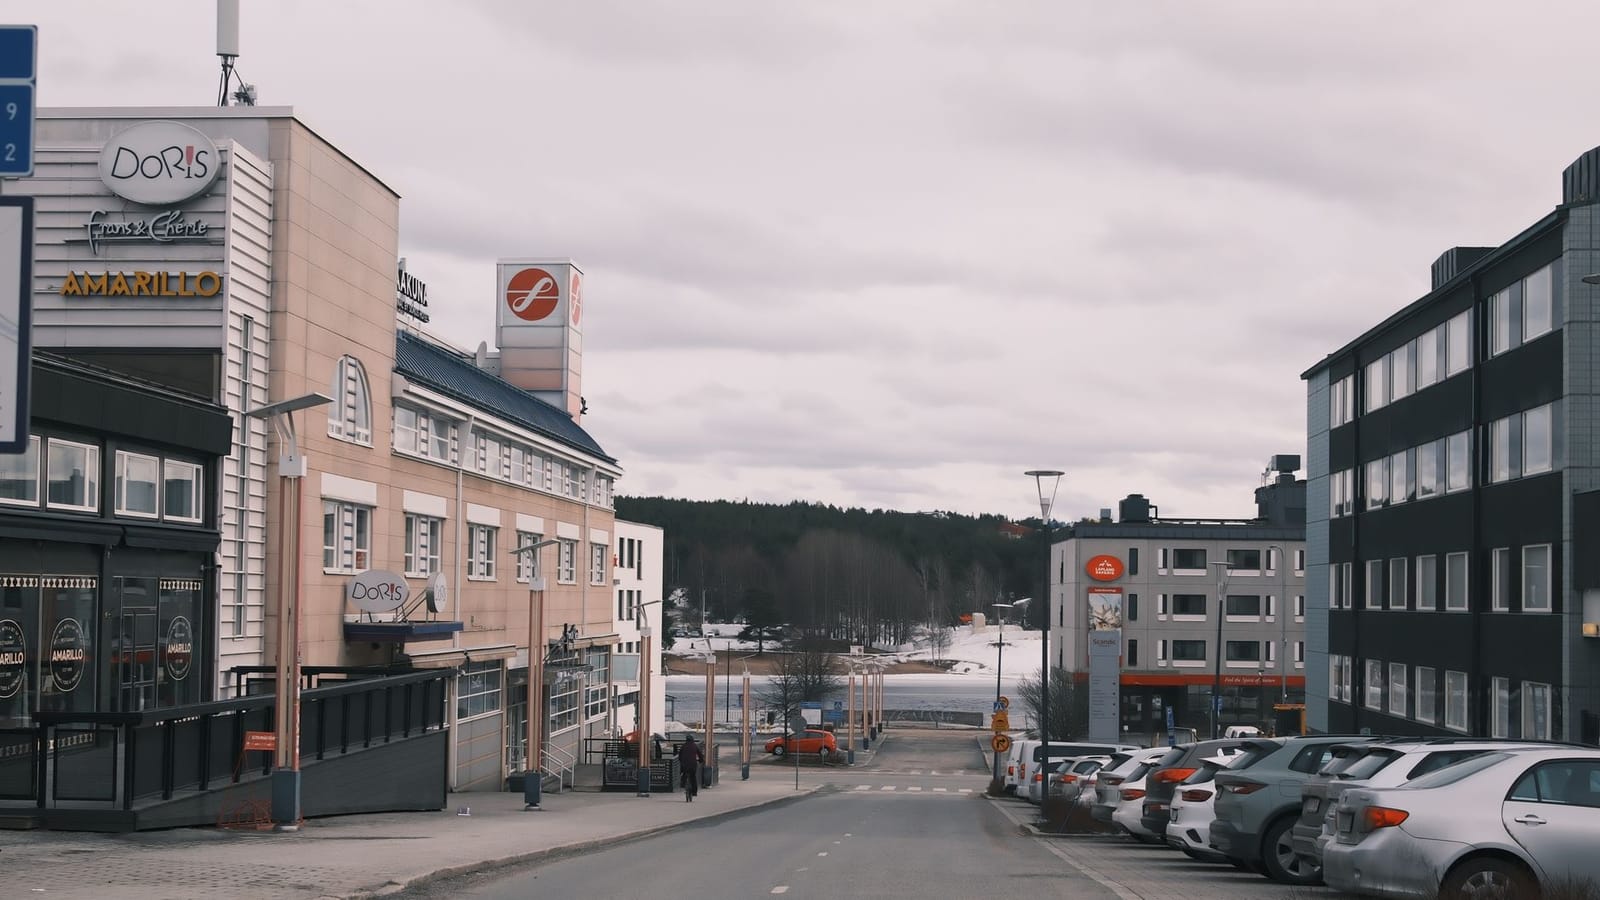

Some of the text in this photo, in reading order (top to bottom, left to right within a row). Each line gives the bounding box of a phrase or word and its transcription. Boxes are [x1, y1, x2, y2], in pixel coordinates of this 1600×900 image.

[6, 102, 17, 120] 9
[5, 144, 16, 161] 2
[60, 271, 221, 297] AMARILLO
[52, 648, 83, 662] AMARILLO
